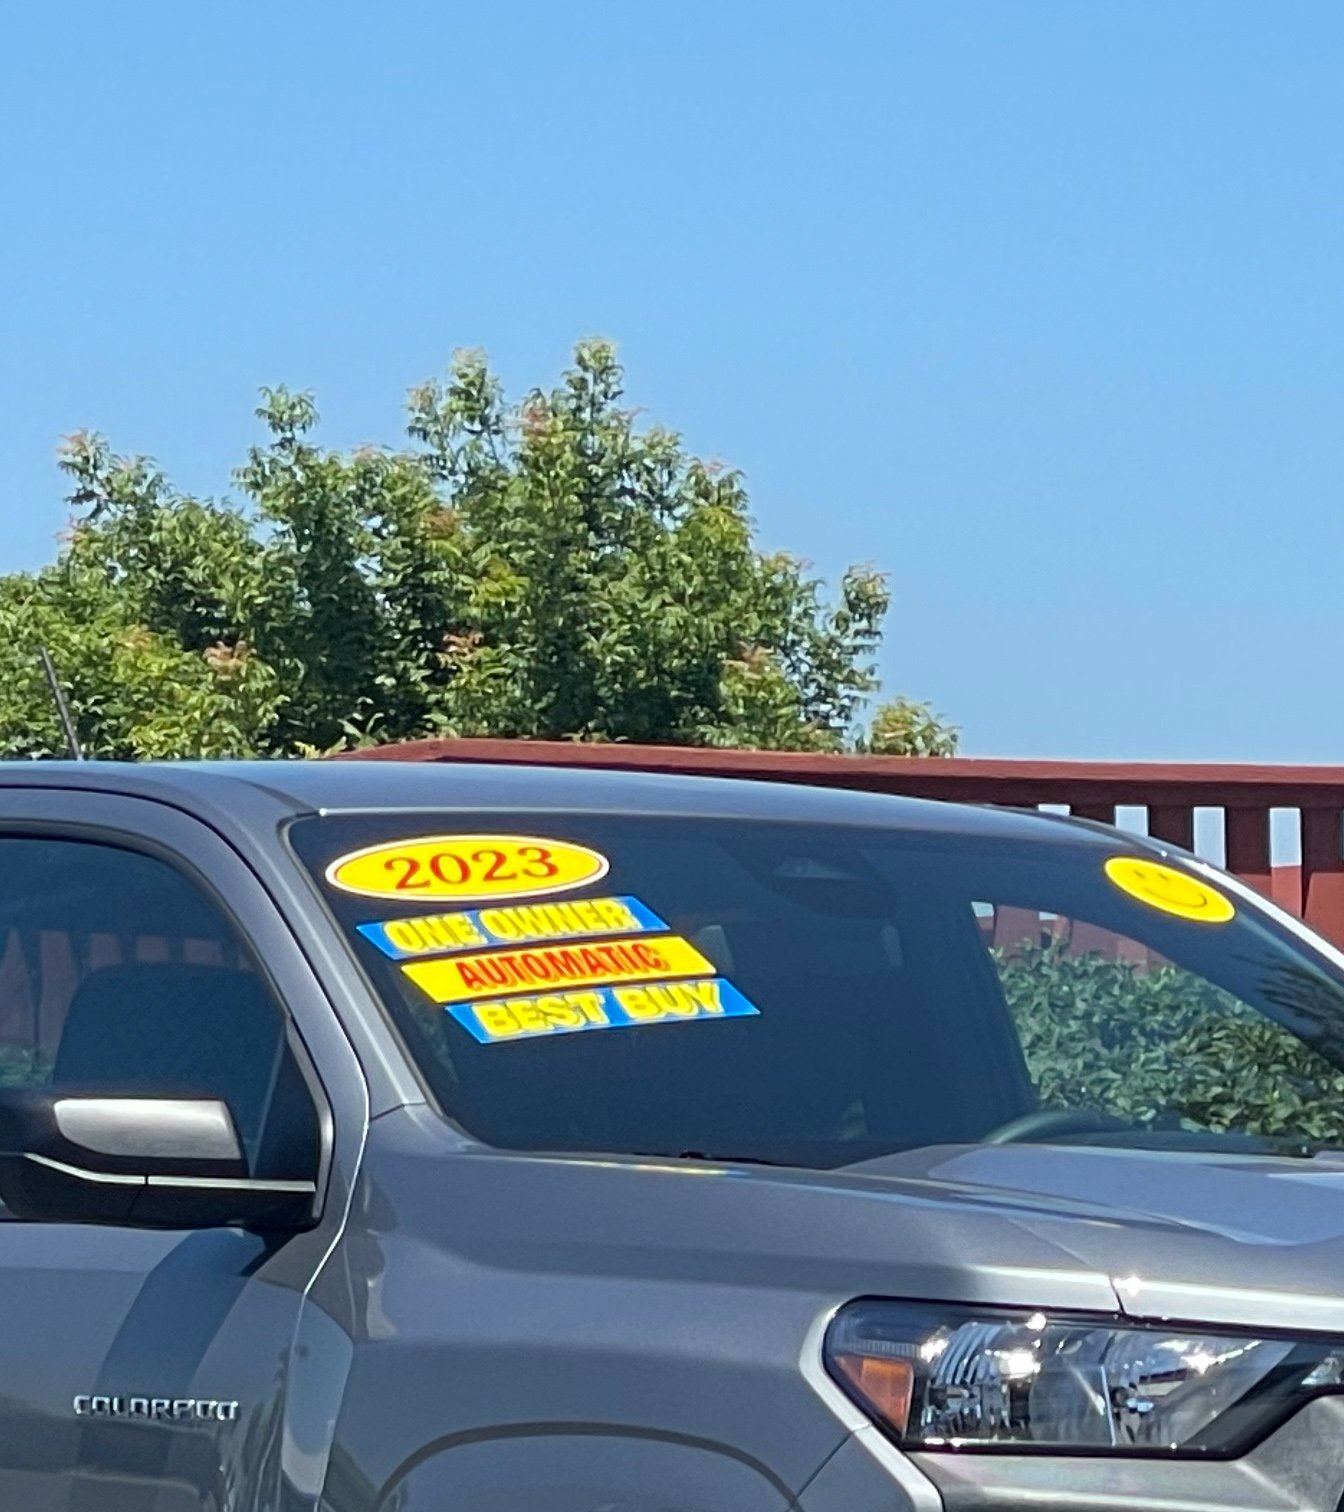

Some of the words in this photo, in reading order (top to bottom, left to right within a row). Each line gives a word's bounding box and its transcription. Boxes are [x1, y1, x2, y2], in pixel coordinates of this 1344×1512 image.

[383, 846, 560, 891] 2023
[382, 915, 485, 953] ONE
[477, 898, 641, 943] OWNER
[456, 942, 668, 991] AUTOMATIC
[471, 994, 609, 1038] BEST
[610, 981, 724, 1019] BUY
